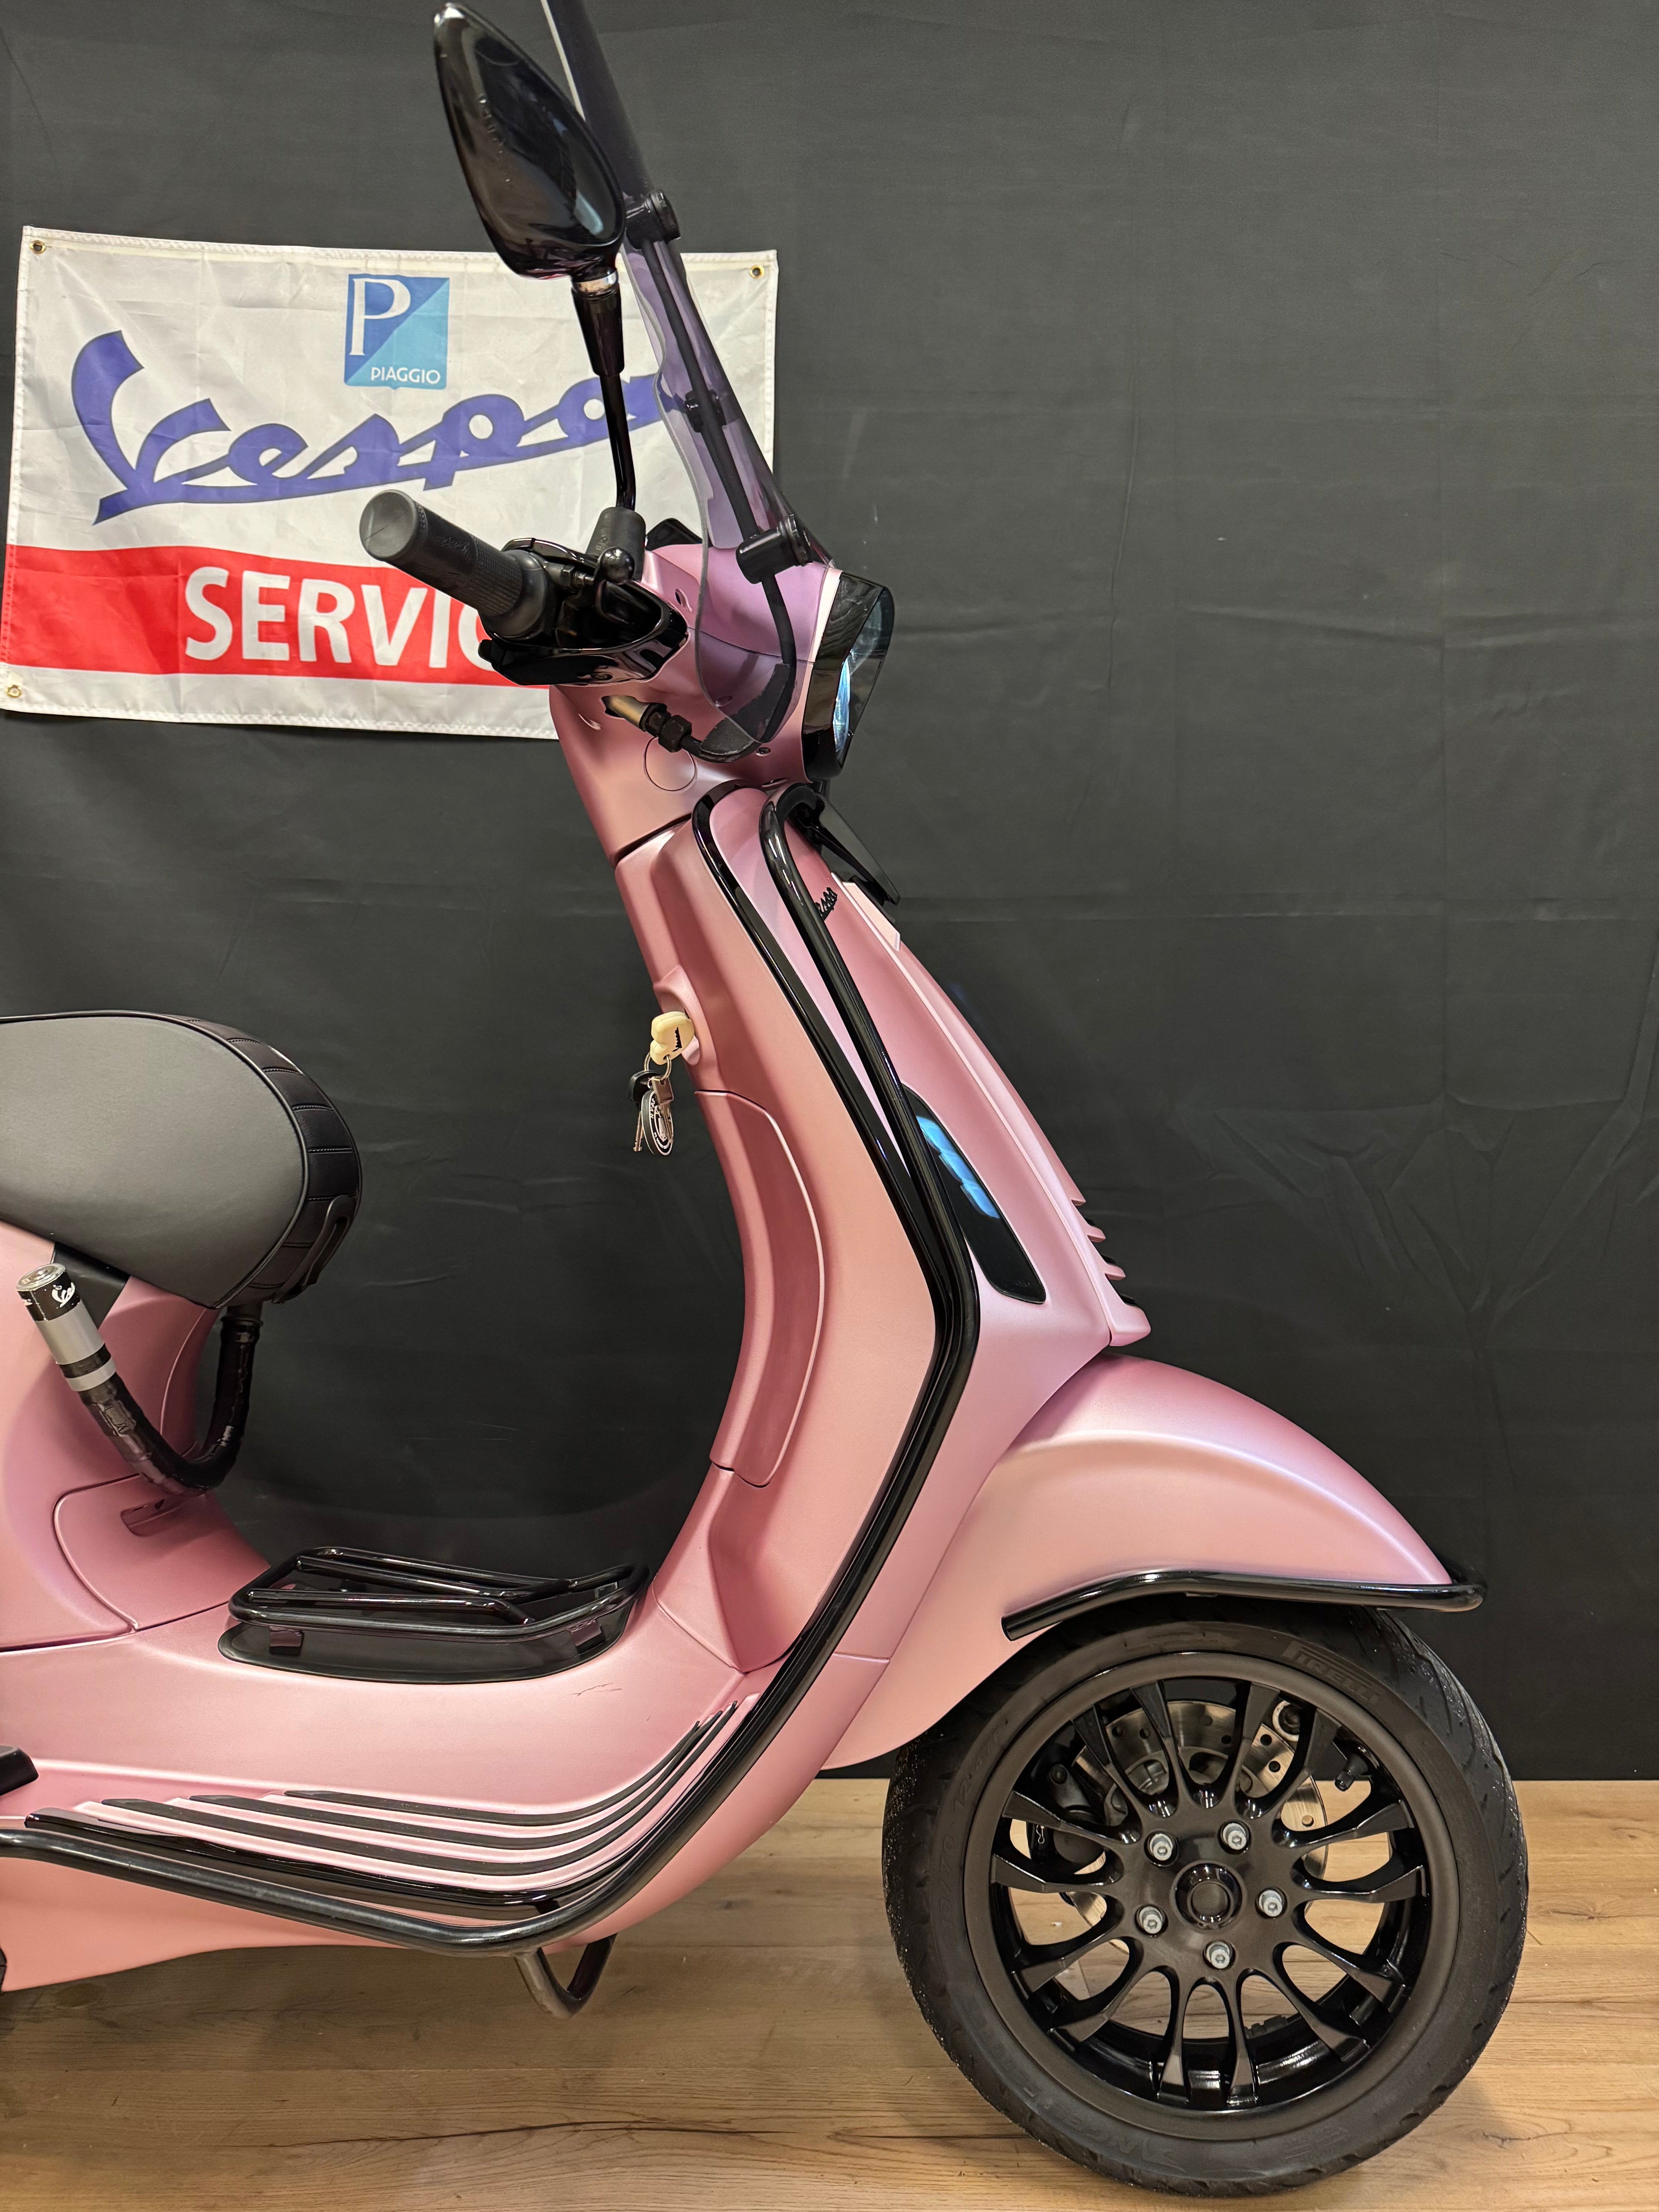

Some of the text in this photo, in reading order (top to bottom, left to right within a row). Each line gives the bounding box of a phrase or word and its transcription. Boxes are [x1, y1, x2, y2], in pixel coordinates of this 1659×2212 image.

[349, 278, 411, 356] P
[370, 367, 441, 384] PIAGGIO
[72, 330, 689, 525] Vespa
[185, 567, 496, 672] SERVIC
[1282, 1641, 1380, 1704] PIRELLI
